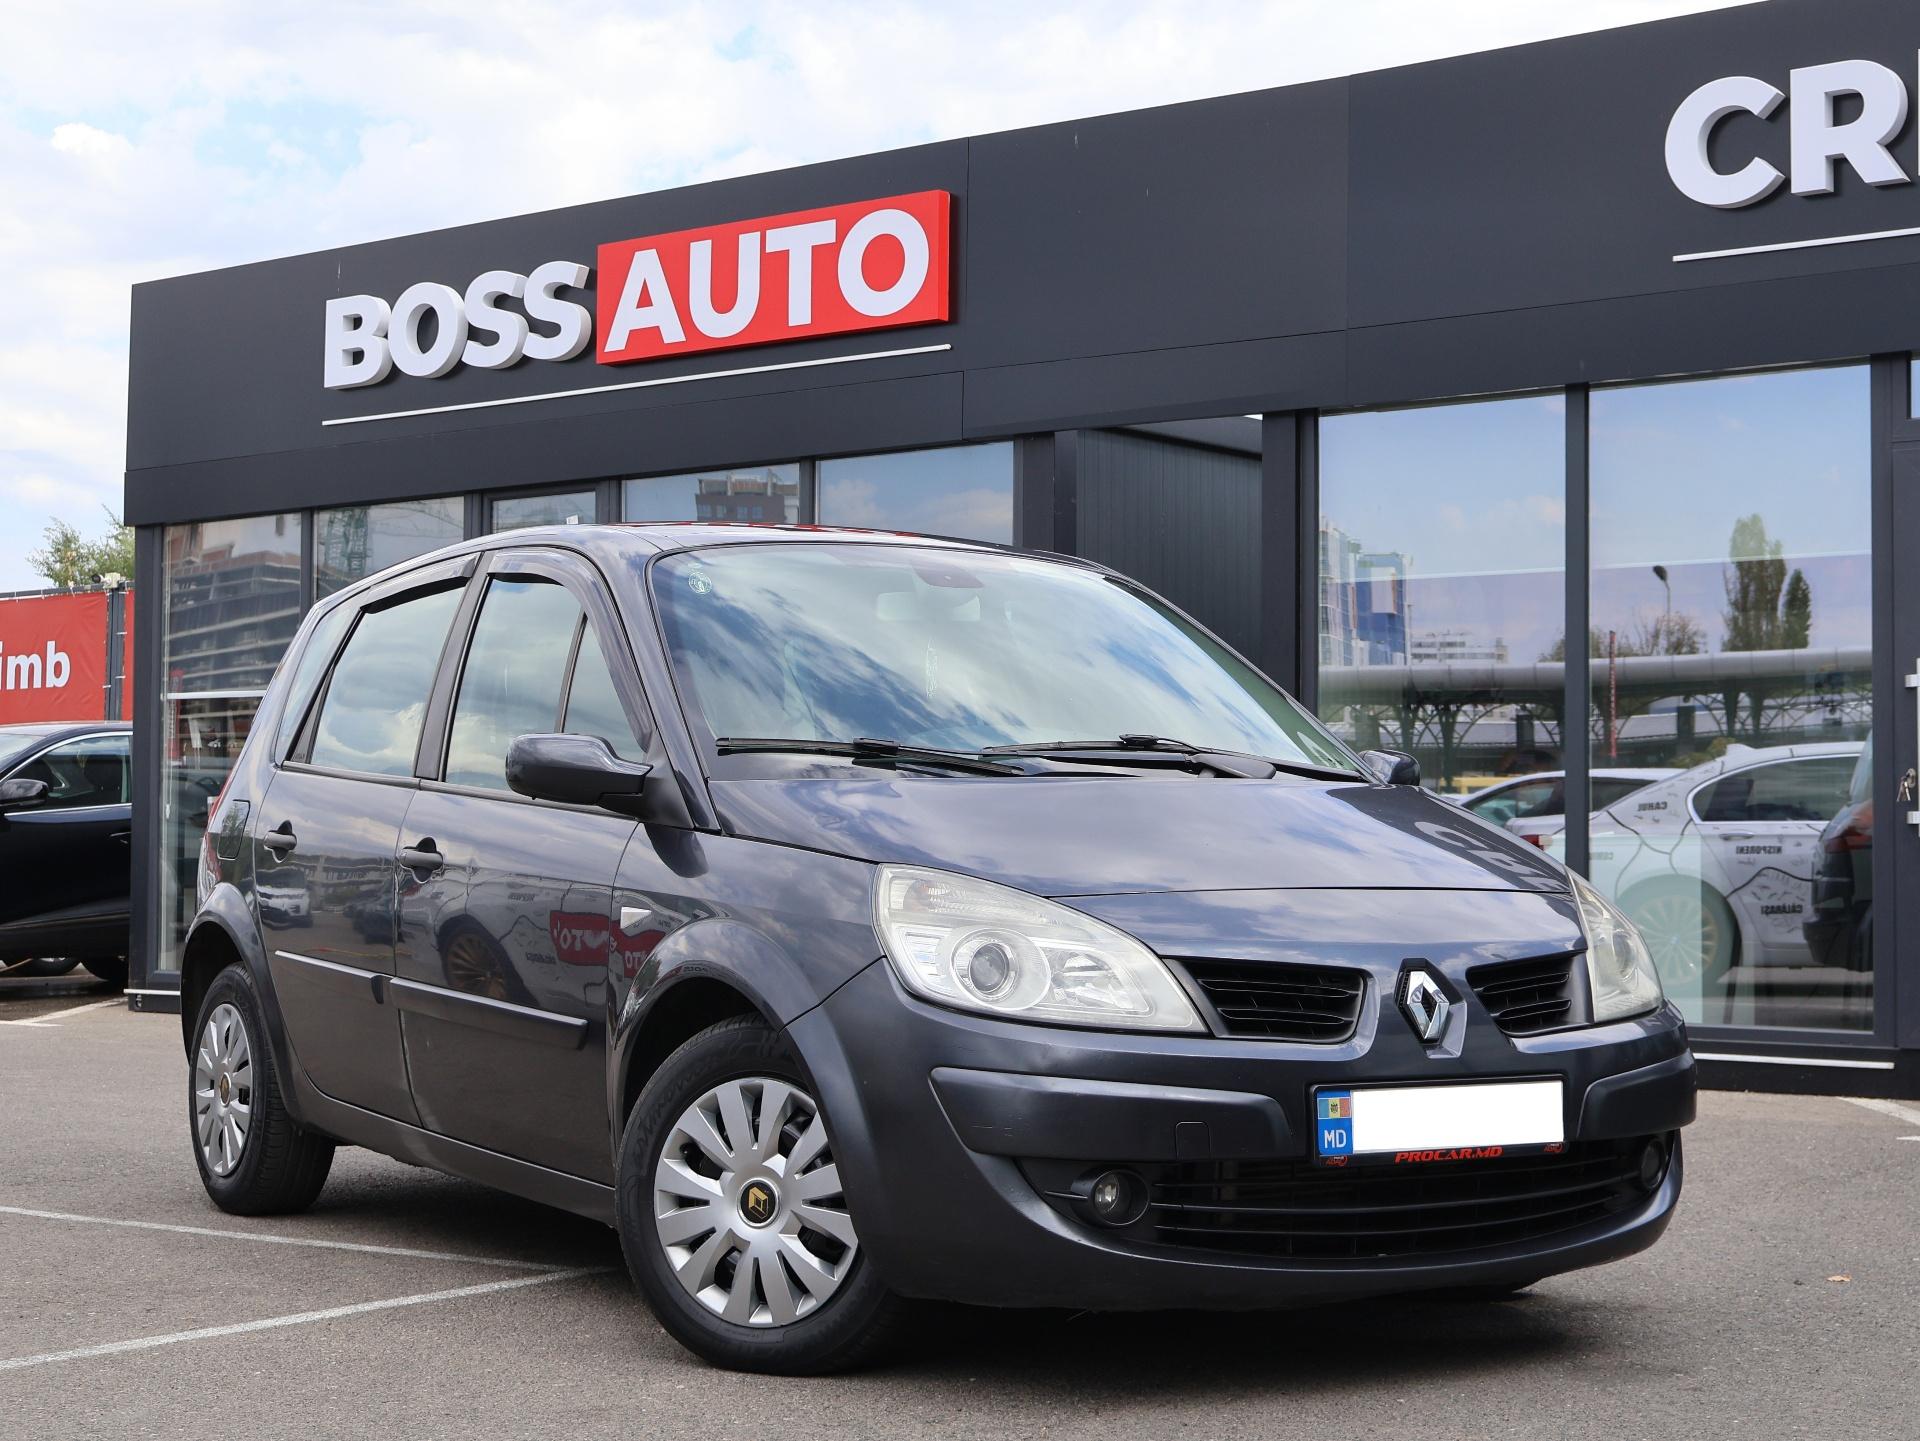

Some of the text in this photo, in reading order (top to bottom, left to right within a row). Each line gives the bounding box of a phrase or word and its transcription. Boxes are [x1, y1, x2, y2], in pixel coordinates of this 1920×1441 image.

[1665, 49, 1920, 208] CR
[324, 208, 930, 390] BOSS AUTO
[0, 640, 71, 690] mb
[1324, 1129, 1347, 1149] MD
[1394, 1146, 1504, 1165] PROCAR.MD
